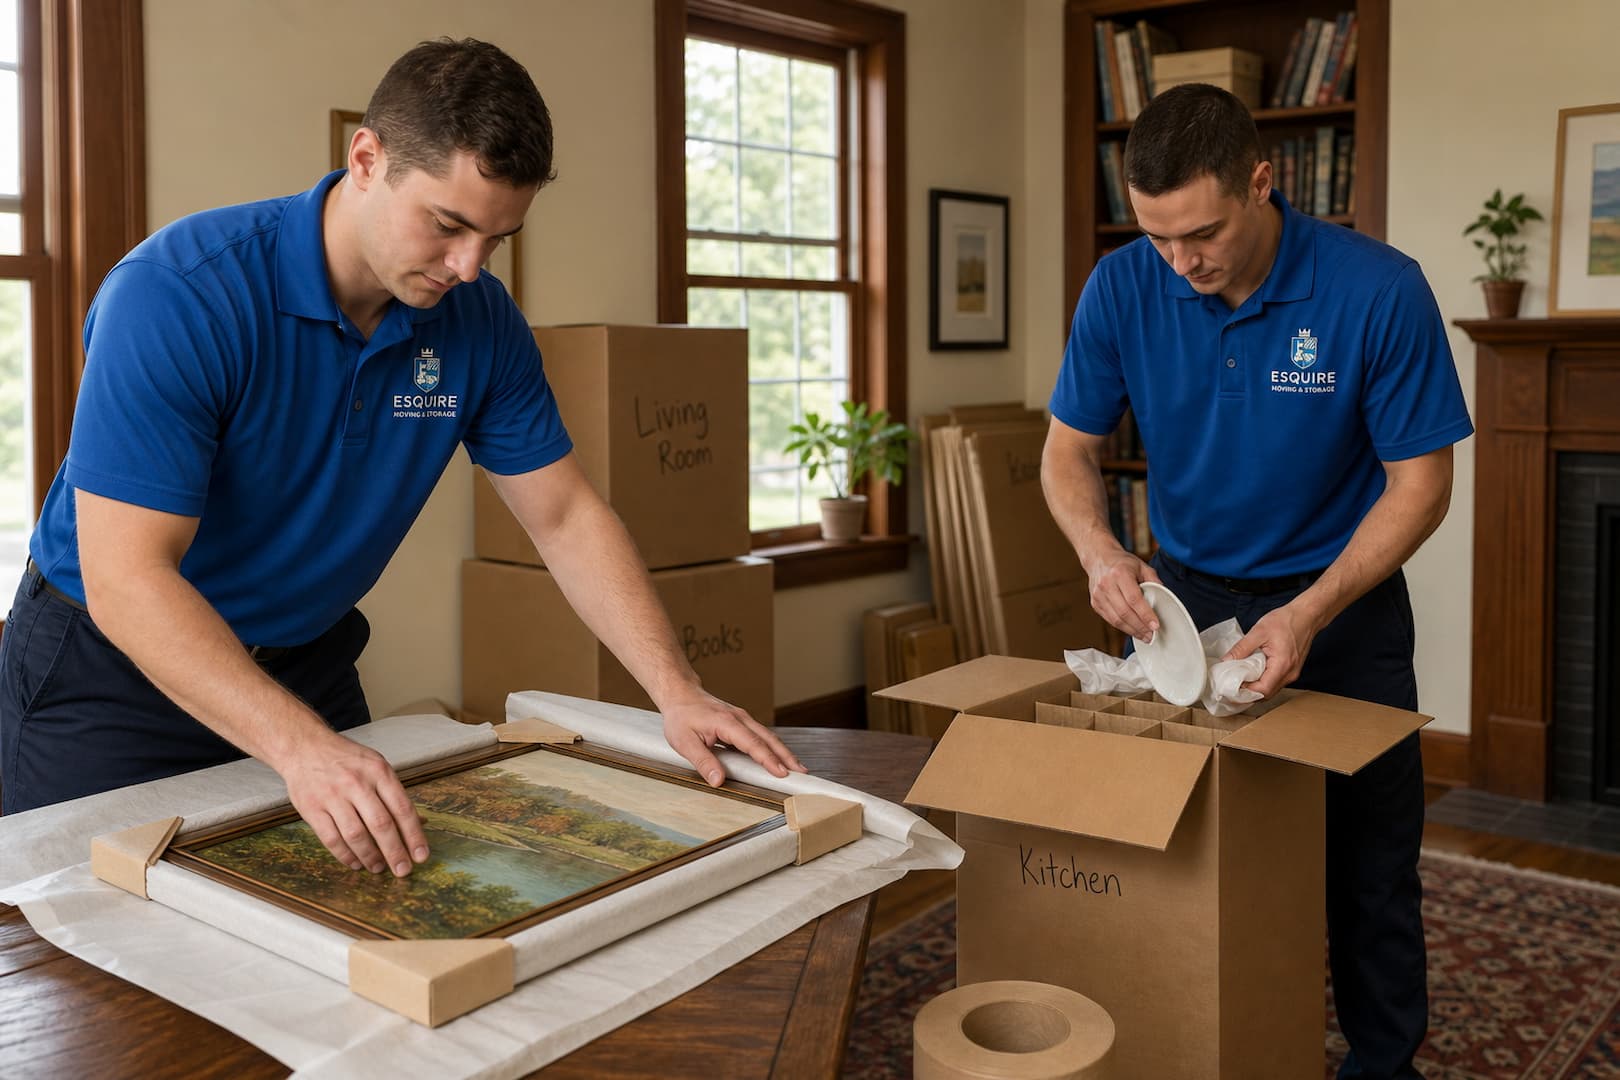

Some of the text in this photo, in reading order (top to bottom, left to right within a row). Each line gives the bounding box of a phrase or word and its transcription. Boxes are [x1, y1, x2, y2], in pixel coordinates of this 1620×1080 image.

[1271, 371, 1336, 384] ESQUIRE
[1271, 385, 1297, 393] MOVING
[393, 395, 458, 409] ESQUIRE
[634, 395, 709, 440] Living
[658, 440, 713, 475] Room
[683, 624, 744, 664] Books
[1019, 843, 1122, 897] Kitchen
